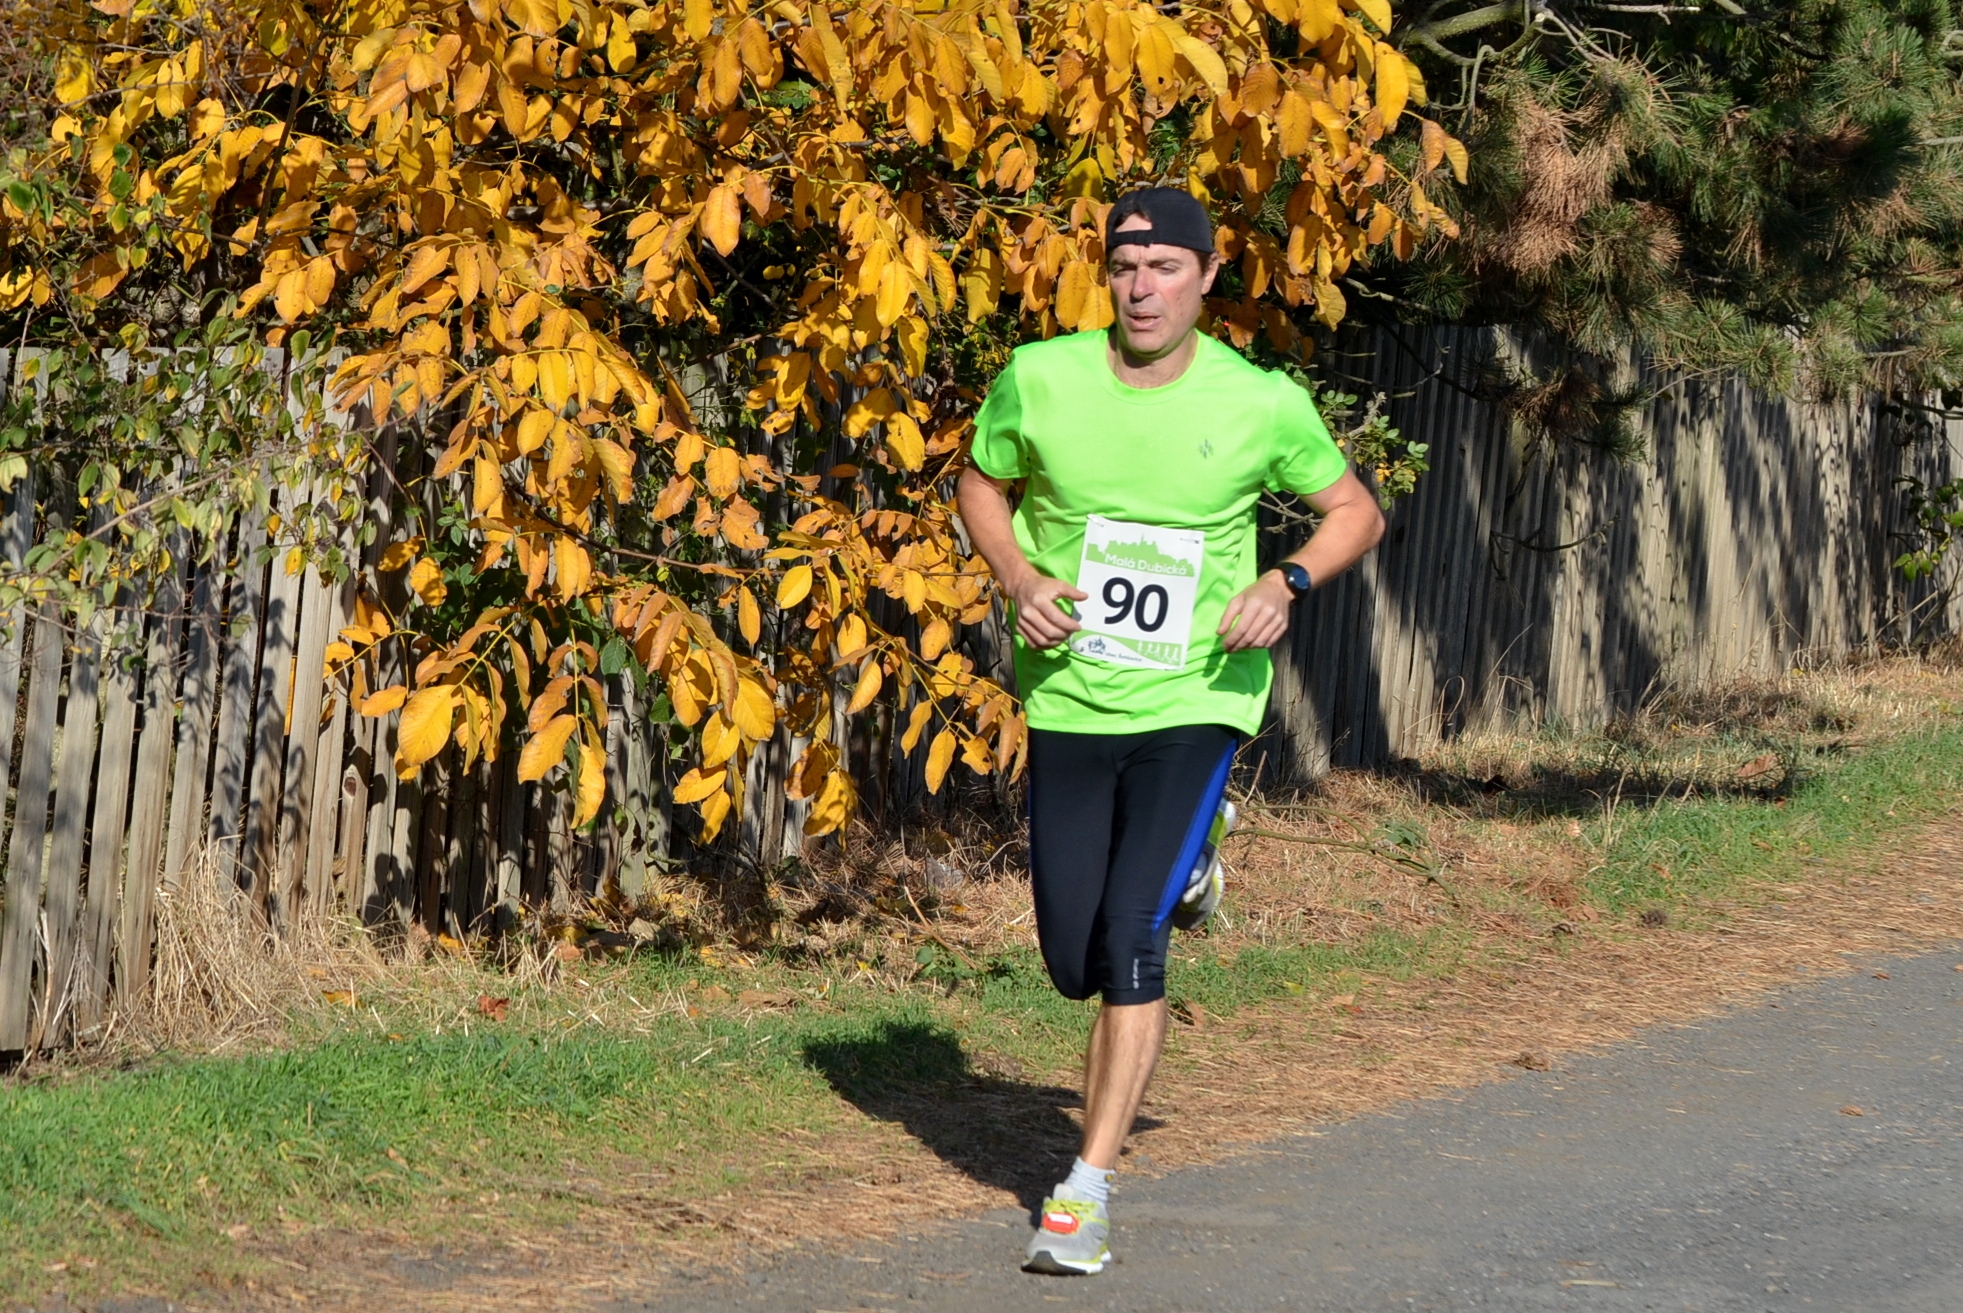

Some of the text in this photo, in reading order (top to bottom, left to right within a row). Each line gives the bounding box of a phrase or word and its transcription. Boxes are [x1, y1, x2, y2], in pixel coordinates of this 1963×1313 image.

[1105, 554, 1187, 575] Malá Dubická
[1103, 577, 1168, 632] 90
